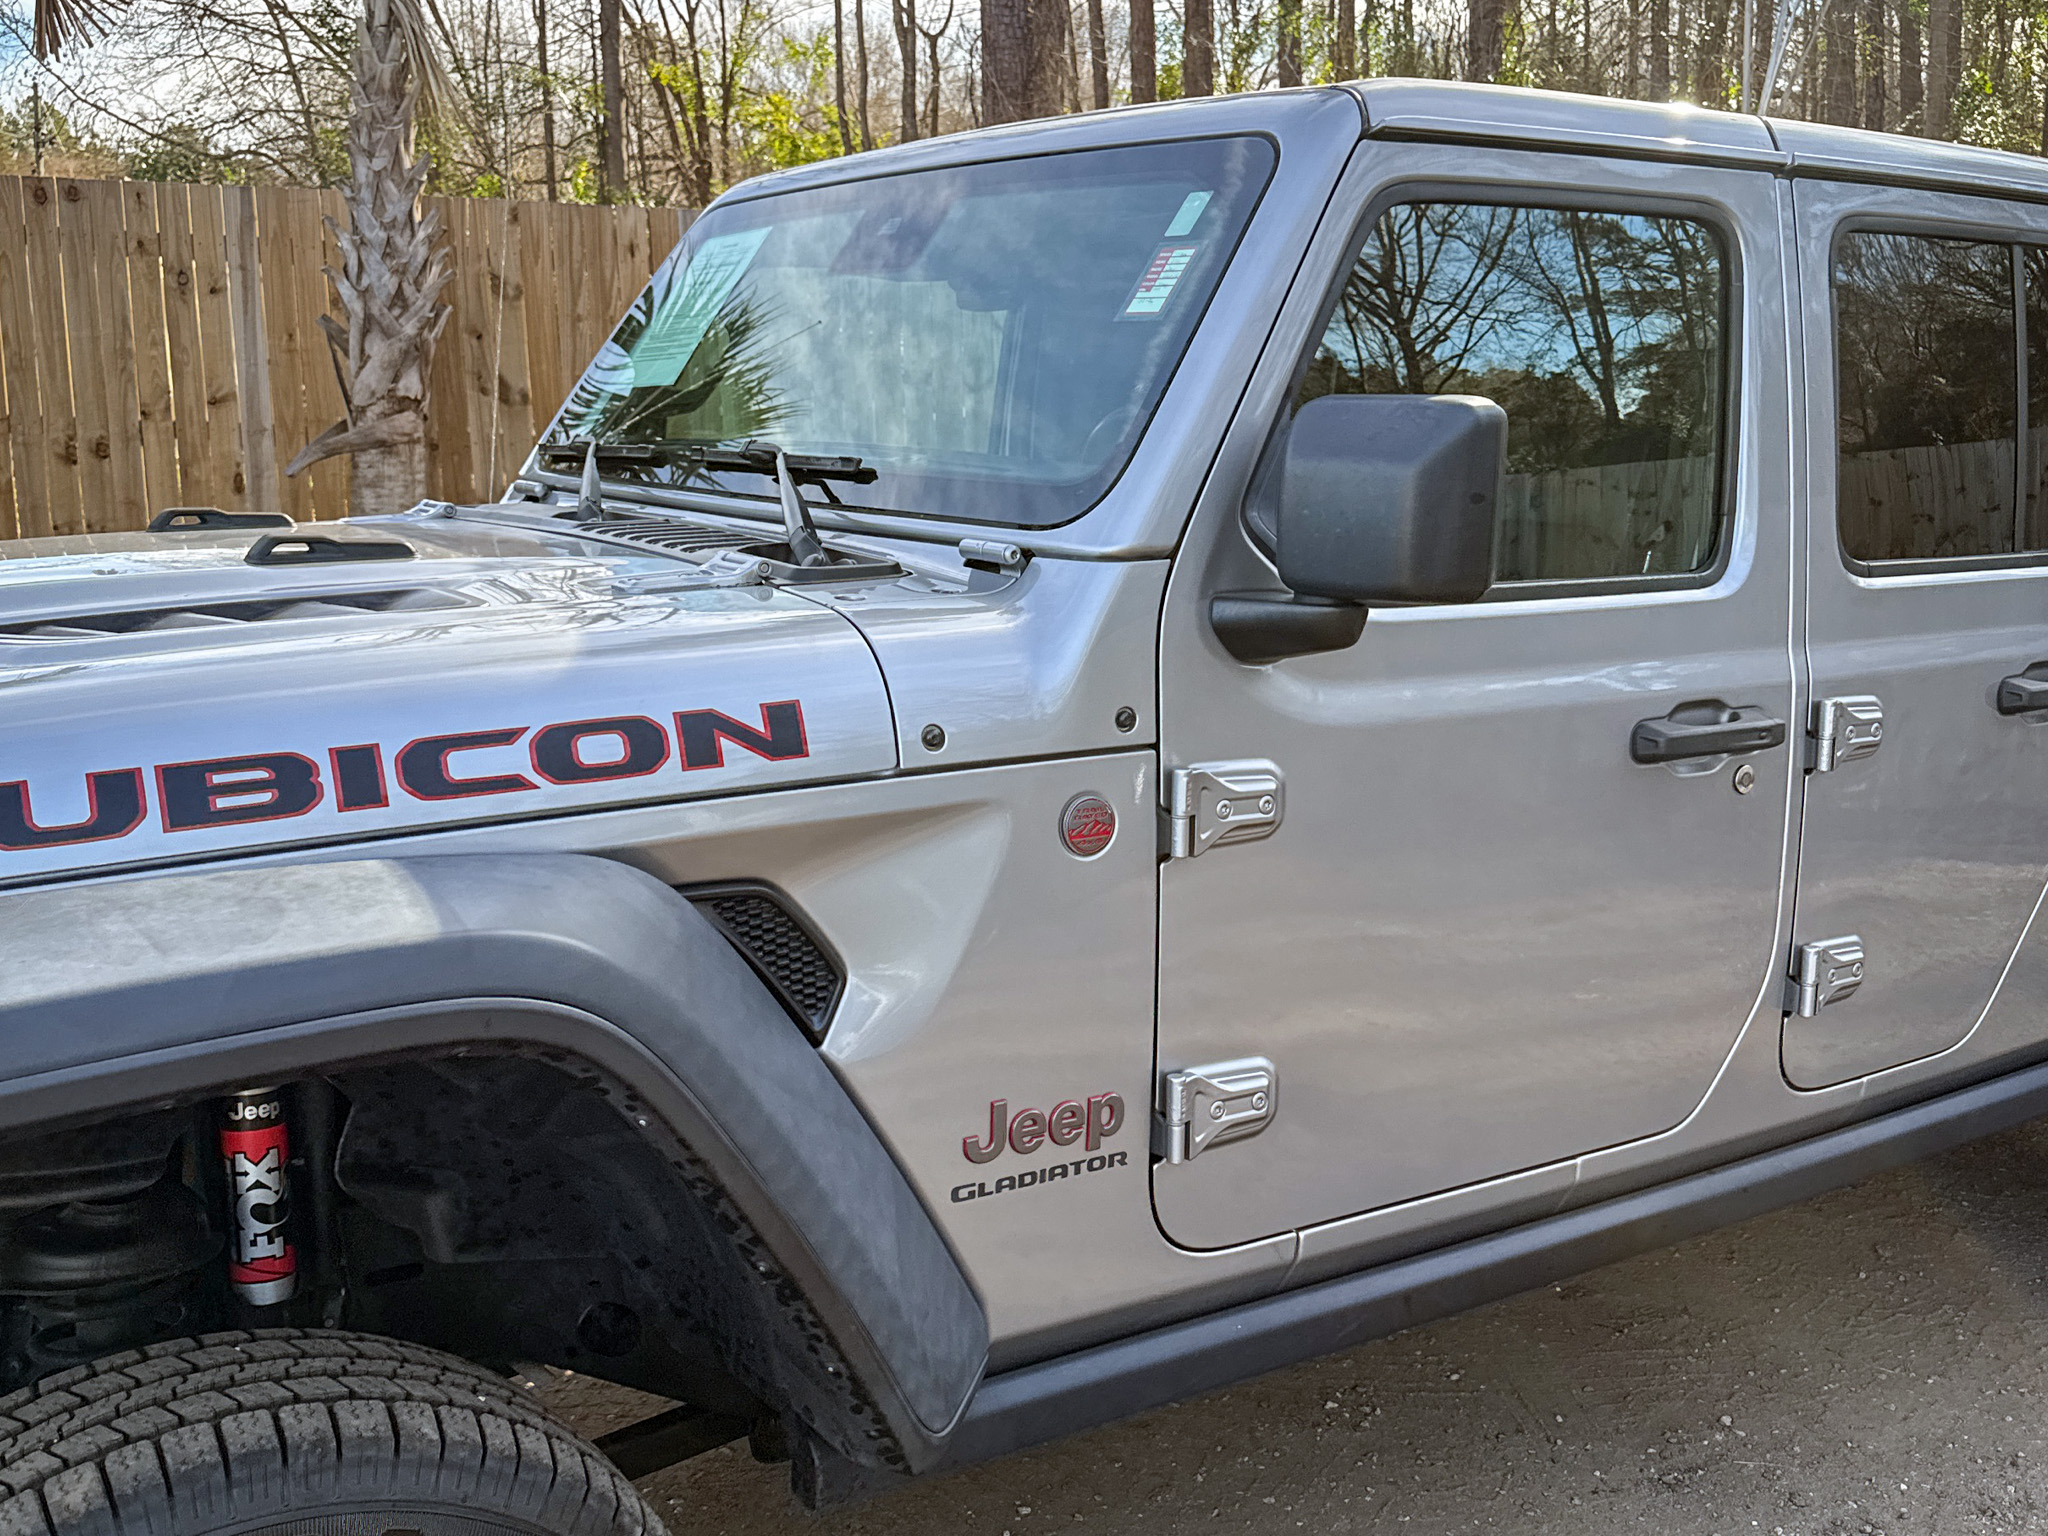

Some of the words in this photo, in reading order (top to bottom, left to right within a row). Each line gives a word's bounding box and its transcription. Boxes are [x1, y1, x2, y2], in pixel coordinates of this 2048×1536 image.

[229, 1102, 280, 1120] Jeep
[963, 1092, 1125, 1164] Jeep
[234, 1148, 289, 1263] FOX
[951, 1151, 1128, 1203] GLADIATOR
